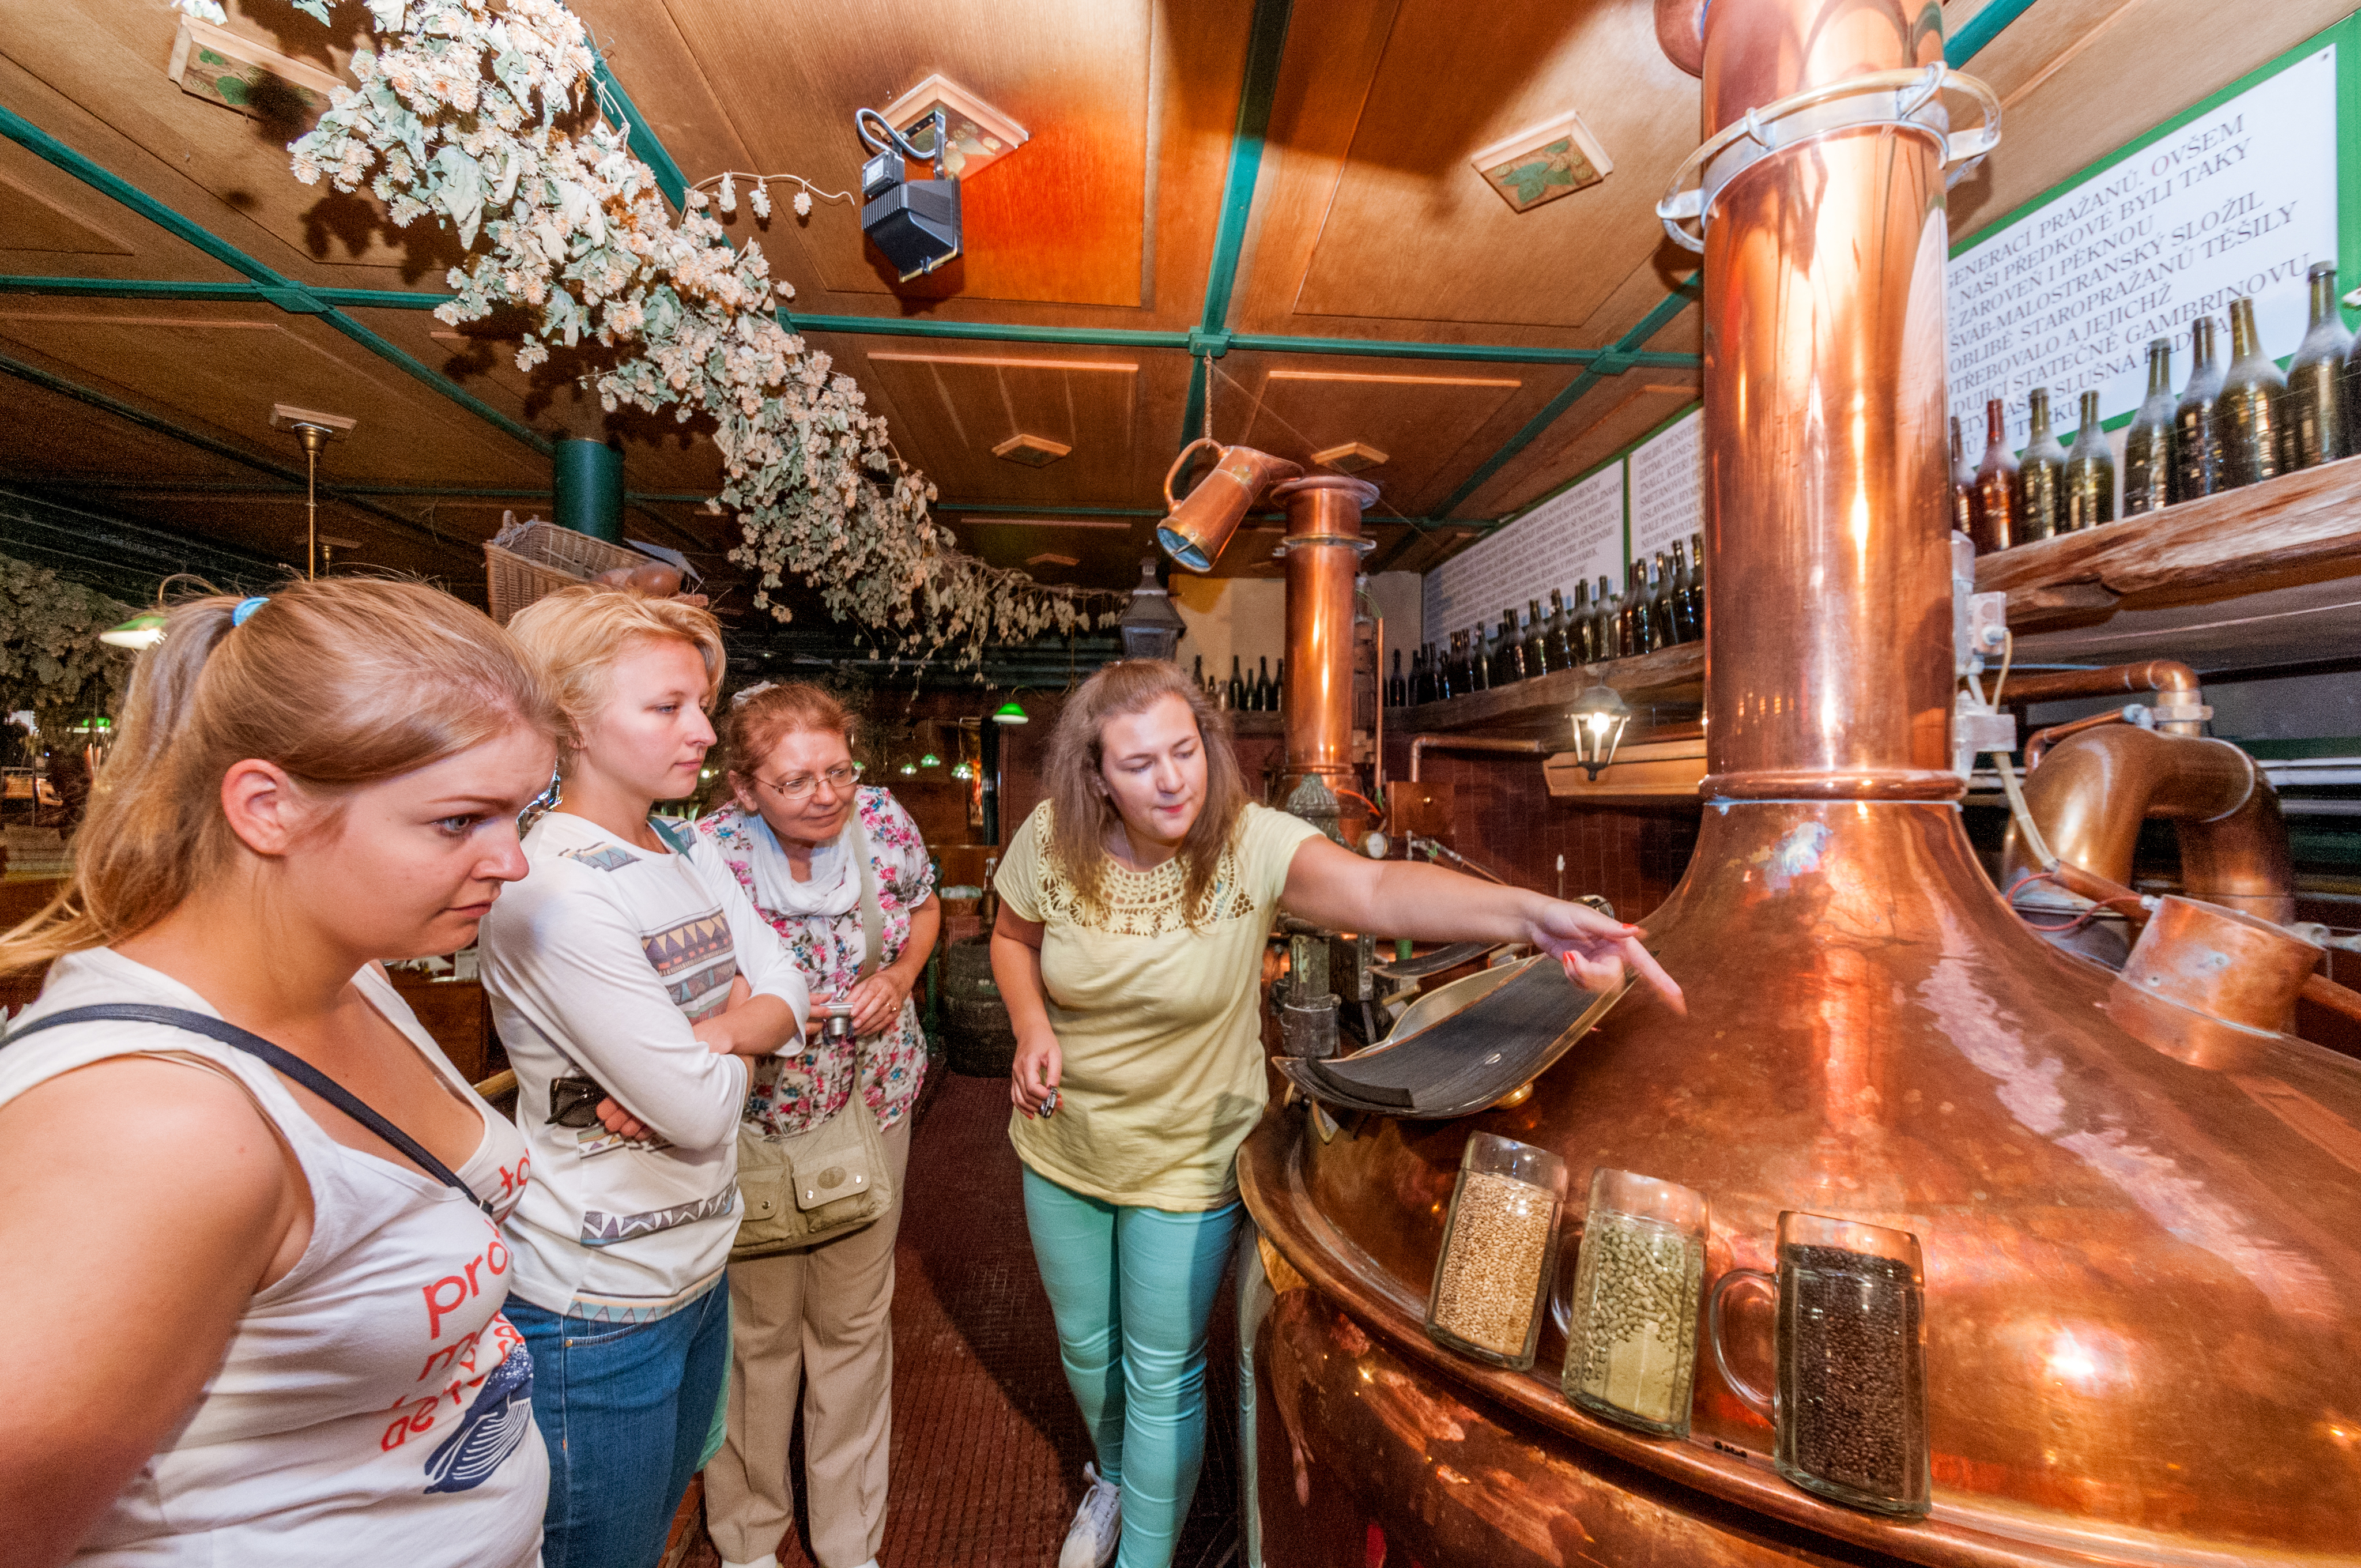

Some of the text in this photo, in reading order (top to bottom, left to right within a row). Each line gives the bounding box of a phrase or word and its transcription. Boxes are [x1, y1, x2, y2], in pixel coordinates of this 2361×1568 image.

[1960, 137, 2253, 305] NAŠI PŘEDKOVÉ BYLI TAKY
[2039, 169, 2144, 239] PRAŽANŮ.
[2152, 112, 2245, 177] OVŠEM
[2171, 191, 2264, 247] SLOŽIL
[1950, 329, 2014, 374] OBLIBĚ
[2021, 246, 2193, 341] STAROPRAŽANŮ
[2200, 200, 2299, 259] TĚŠILY
[1960, 270, 2042, 327] ZÁROVEŇ
[2061, 214, 2154, 276] PĚKNOU
[2013, 330, 2118, 391] STATEČNĚ
[2126, 252, 2310, 344] GAMBRINOVU
[1949, 336, 2060, 395] TŘEBOVALO
[2066, 328, 2079, 346] A
[2083, 282, 2173, 341] JEJICHŽ
[2054, 349, 2136, 398] SLUŠNÁ
[423, 1219, 513, 1340] pro
